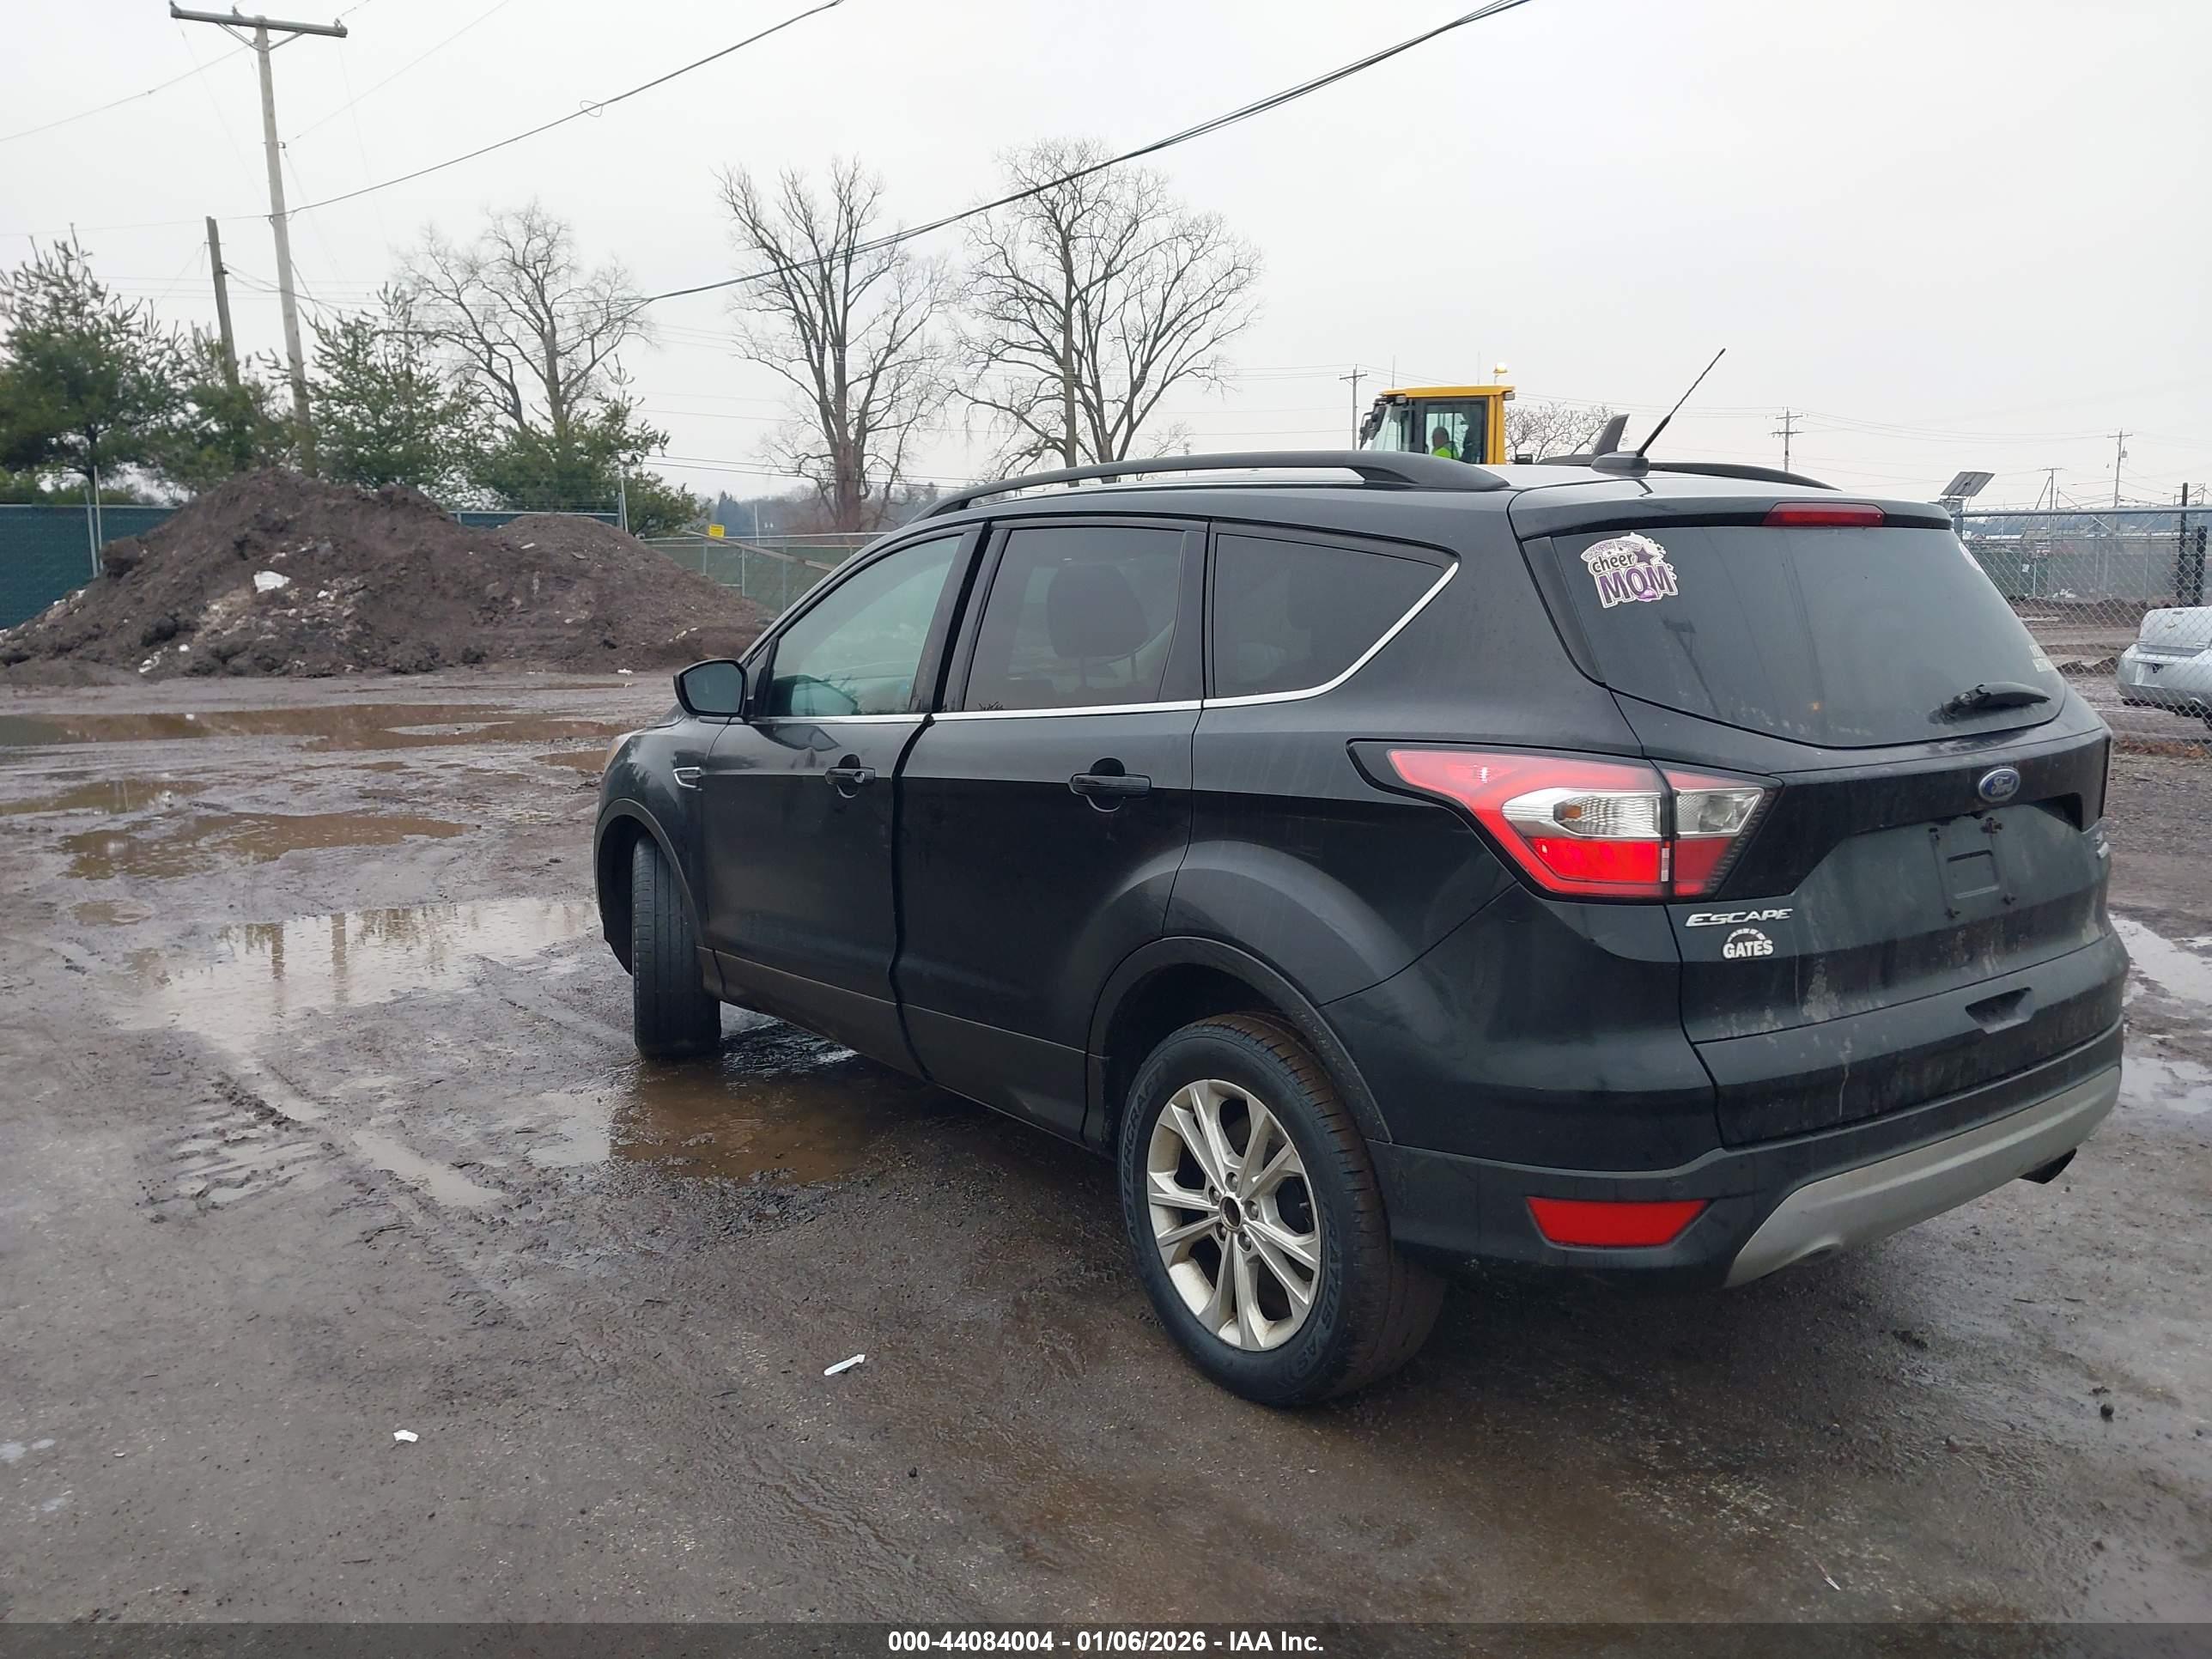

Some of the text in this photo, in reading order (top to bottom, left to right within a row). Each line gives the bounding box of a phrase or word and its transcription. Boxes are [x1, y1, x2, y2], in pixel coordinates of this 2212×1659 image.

[1592, 553, 1634, 574] cheer
[1598, 564, 1674, 605] MOM
[1723, 939, 1774, 959] GATES
